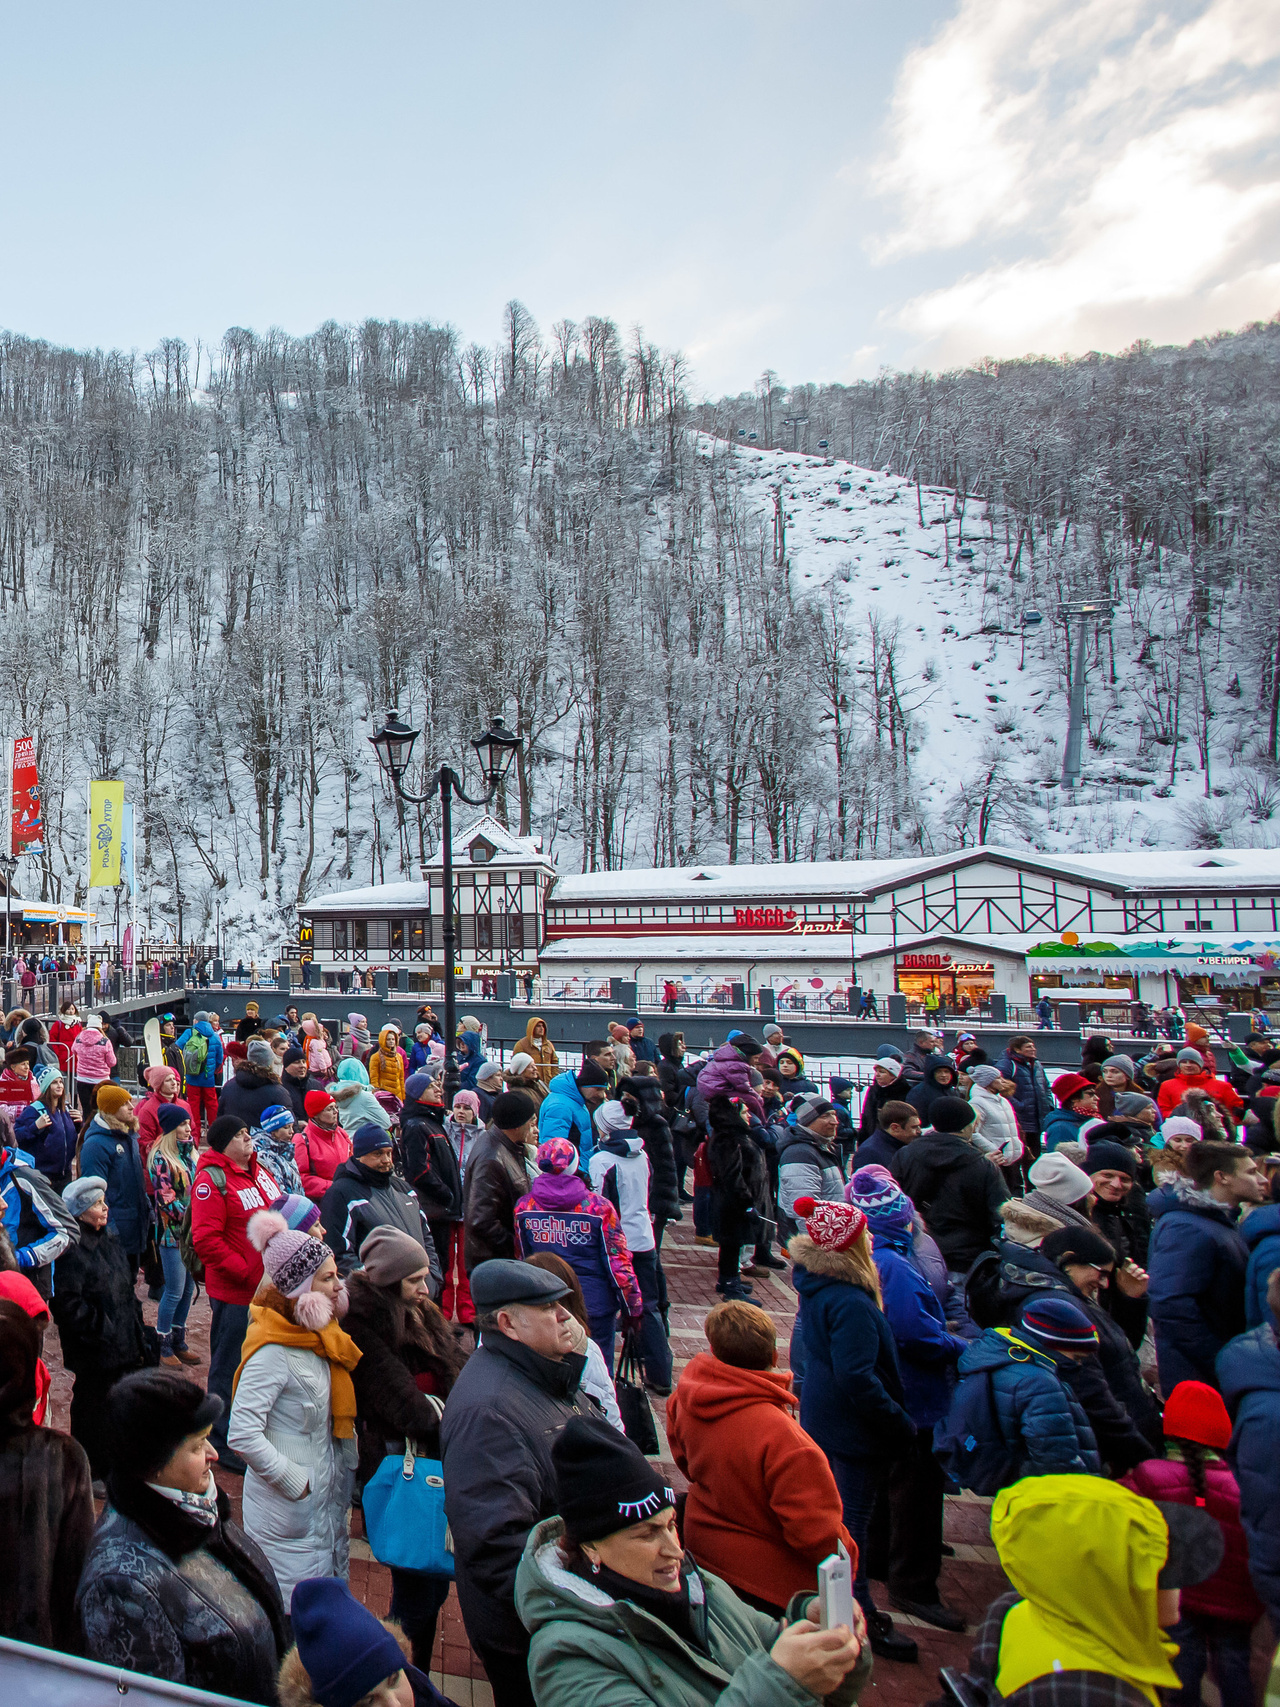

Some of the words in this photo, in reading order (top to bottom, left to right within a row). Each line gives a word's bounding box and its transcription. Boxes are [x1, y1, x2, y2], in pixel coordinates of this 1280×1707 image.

[16, 740, 34, 752] 500
[104, 798, 113, 822] ХУТОР
[102, 848, 110, 868] РОЗА
[735, 908, 785, 927] BOSCO
[793, 918, 844, 936] Sport
[903, 954, 942, 968] BOSCO
[949, 961, 990, 974] Sport
[1196, 956, 1252, 965] СУВЕНИРЫ
[237, 1187, 265, 1211] RUS
[525, 1216, 590, 1233] sochi.ru
[532, 1231, 567, 1247] 2014
